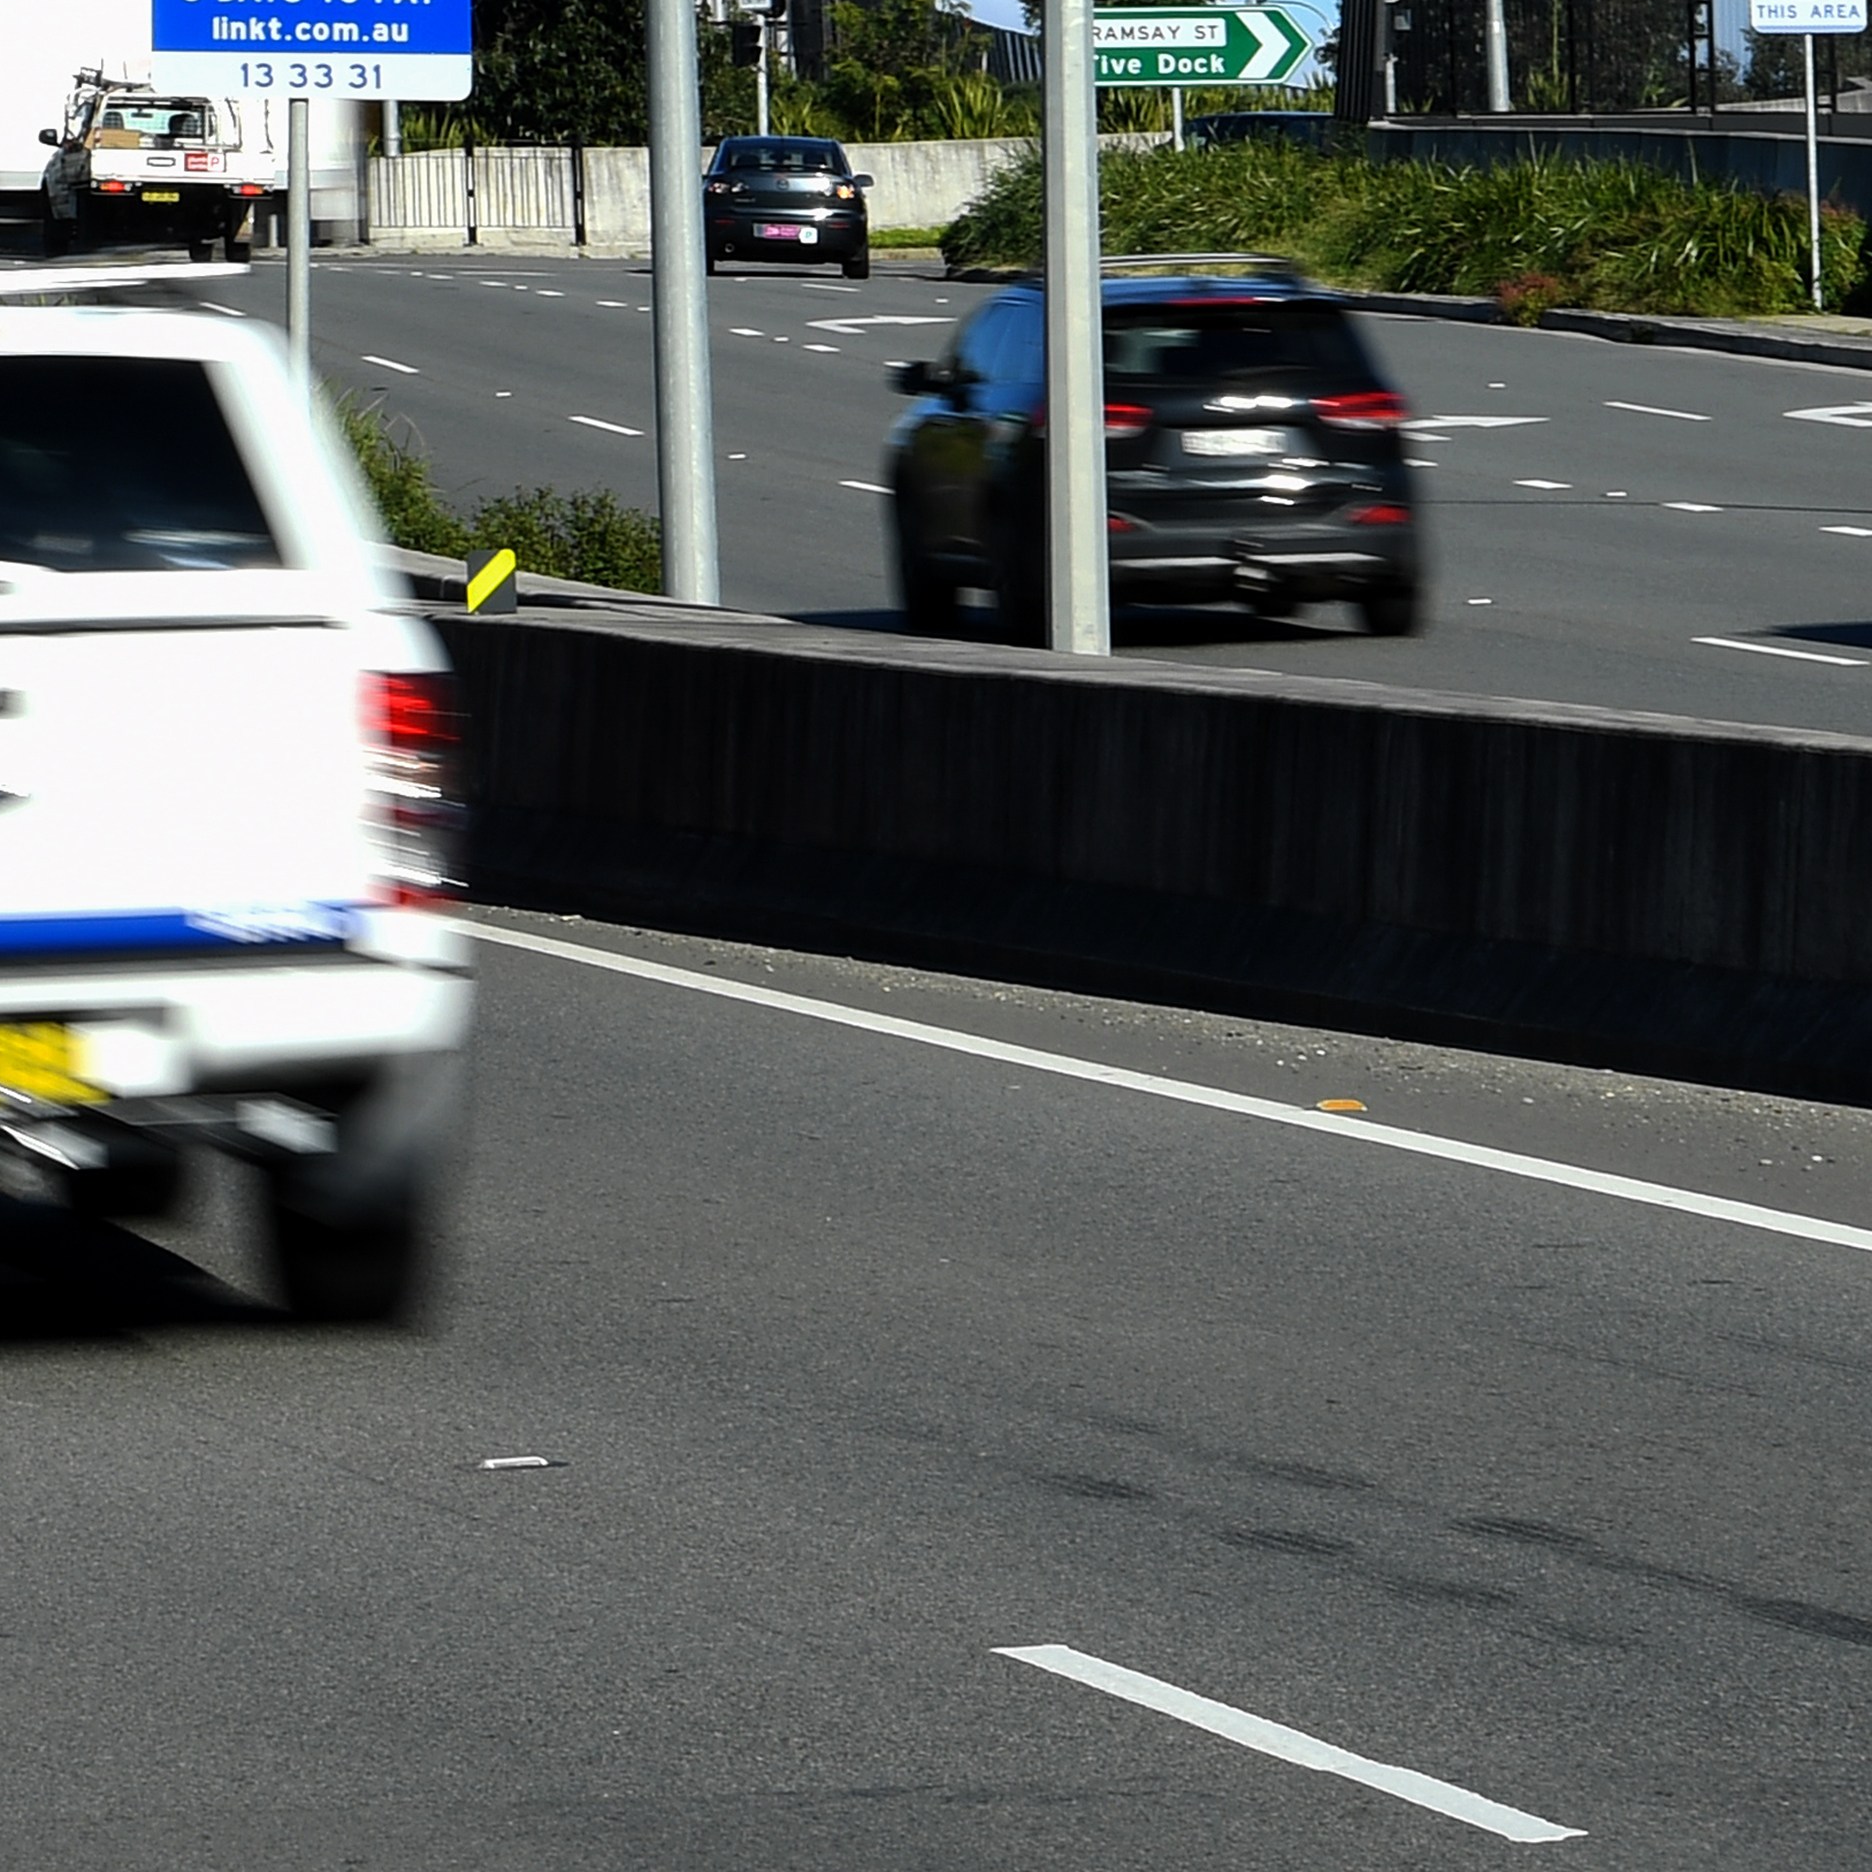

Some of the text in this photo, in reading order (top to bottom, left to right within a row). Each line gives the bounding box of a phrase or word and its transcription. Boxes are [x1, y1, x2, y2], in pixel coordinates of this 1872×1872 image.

[1756, 4, 1861, 18] THIS AREA
[212, 16, 409, 43] linkt.com.au
[1194, 24, 1219, 39] ST
[1158, 52, 1225, 75] Dock
[240, 62, 382, 89] 13 33 31
